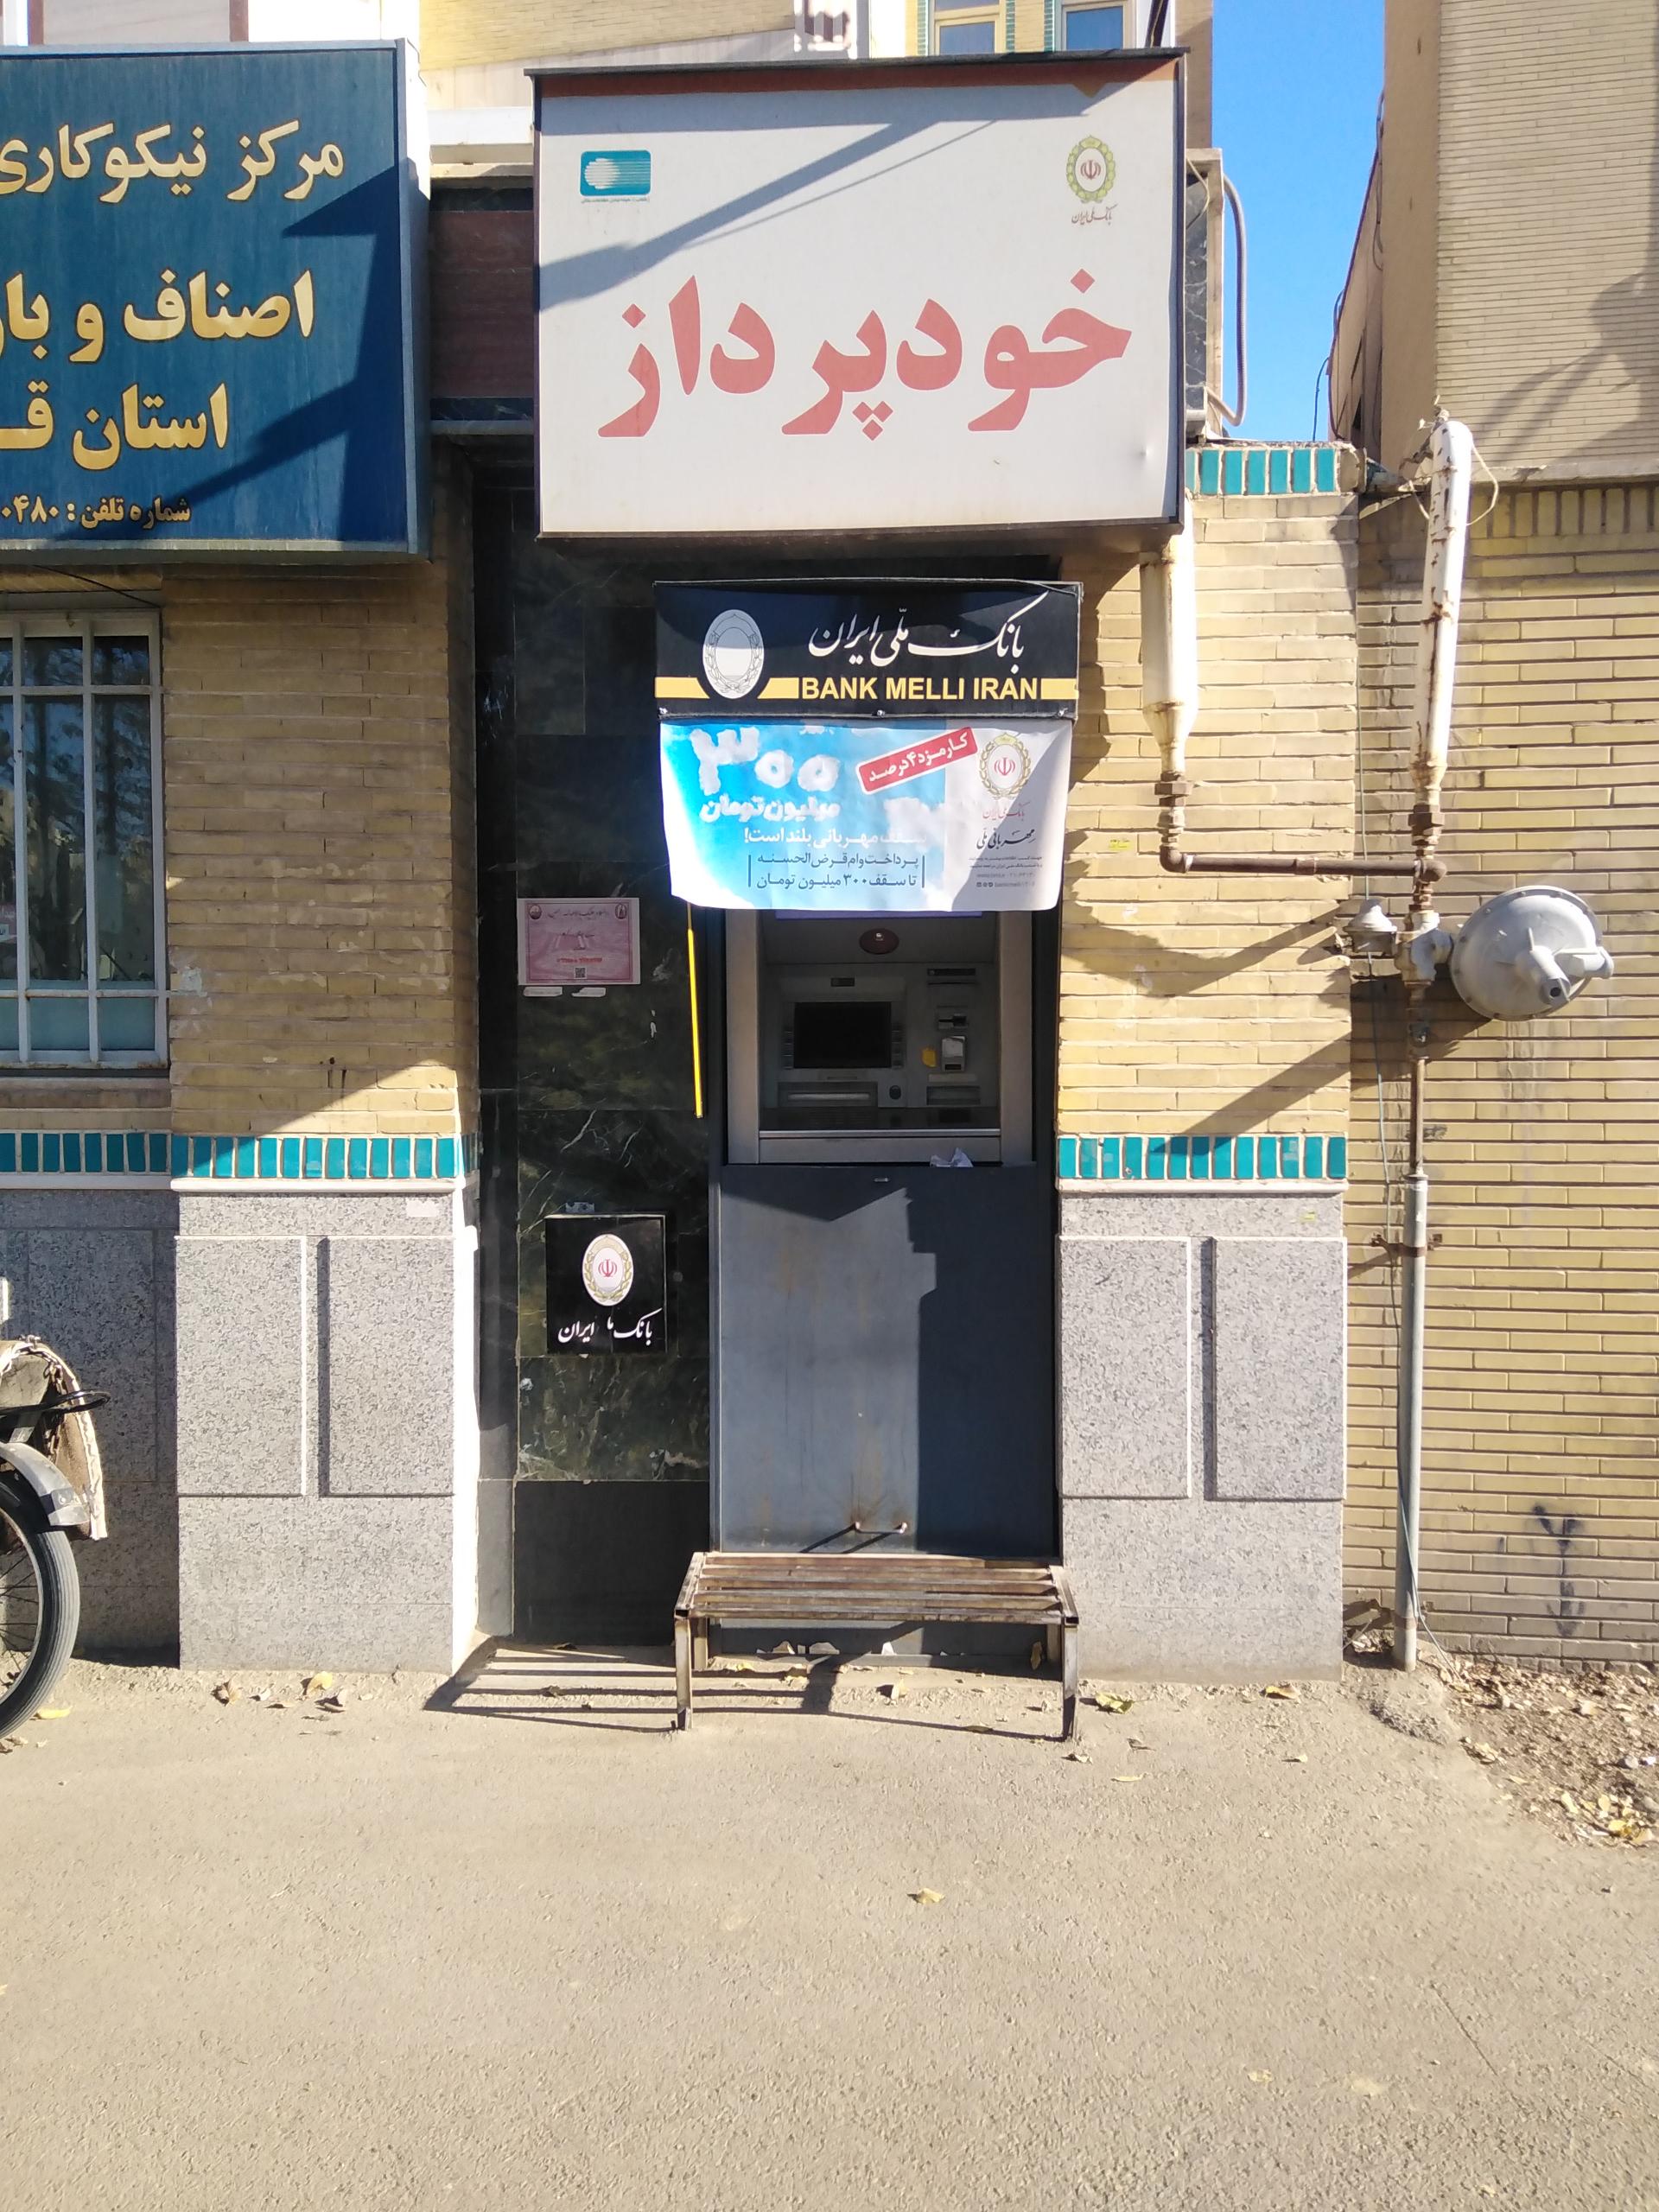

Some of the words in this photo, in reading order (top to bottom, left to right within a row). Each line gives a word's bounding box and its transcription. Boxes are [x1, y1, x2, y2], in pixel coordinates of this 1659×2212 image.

[0, 122, 207, 204] نیکوکاری
[226, 119, 345, 201] مرکز
[0, 272, 50, 360] با
[124, 268, 315, 341] اصناف
[68, 302, 104, 363] و
[597, 268, 1133, 442] خودپرداز
[0, 380, 54, 449] ق
[72, 382, 229, 471] استان
[129, 495, 191, 530] شماره
[808, 613, 880, 665] ایران
[907, 589, 1049, 675] بانک
[802, 677, 878, 700] BANK
[886, 677, 964, 700] MELLI
[973, 677, 1037, 700] IRAN
[689, 726, 841, 797] ۳۰۰
[917, 732, 968, 766] کارمزد
[868, 758, 910, 783] درصد
[699, 793, 765, 823] تومان
[763, 796, 841, 822] میلیون
[785, 826, 812, 848] بلند
[812, 827, 878, 849] مهربانی
[757, 852, 811, 865] الحسنه
[810, 852, 848, 868] قرض
[848, 853, 864, 869] وام
[864, 852, 919, 869] پرداخت
[756, 873, 796, 890] تومان
[798, 873, 842, 890] میلیون
[842, 874, 866, 887] ۳۰۰
[868, 874, 906, 887] سقف
[908, 874, 918, 887] تا
[557, 1320, 595, 1344] ایران
[613, 1307, 663, 1346] بانک
